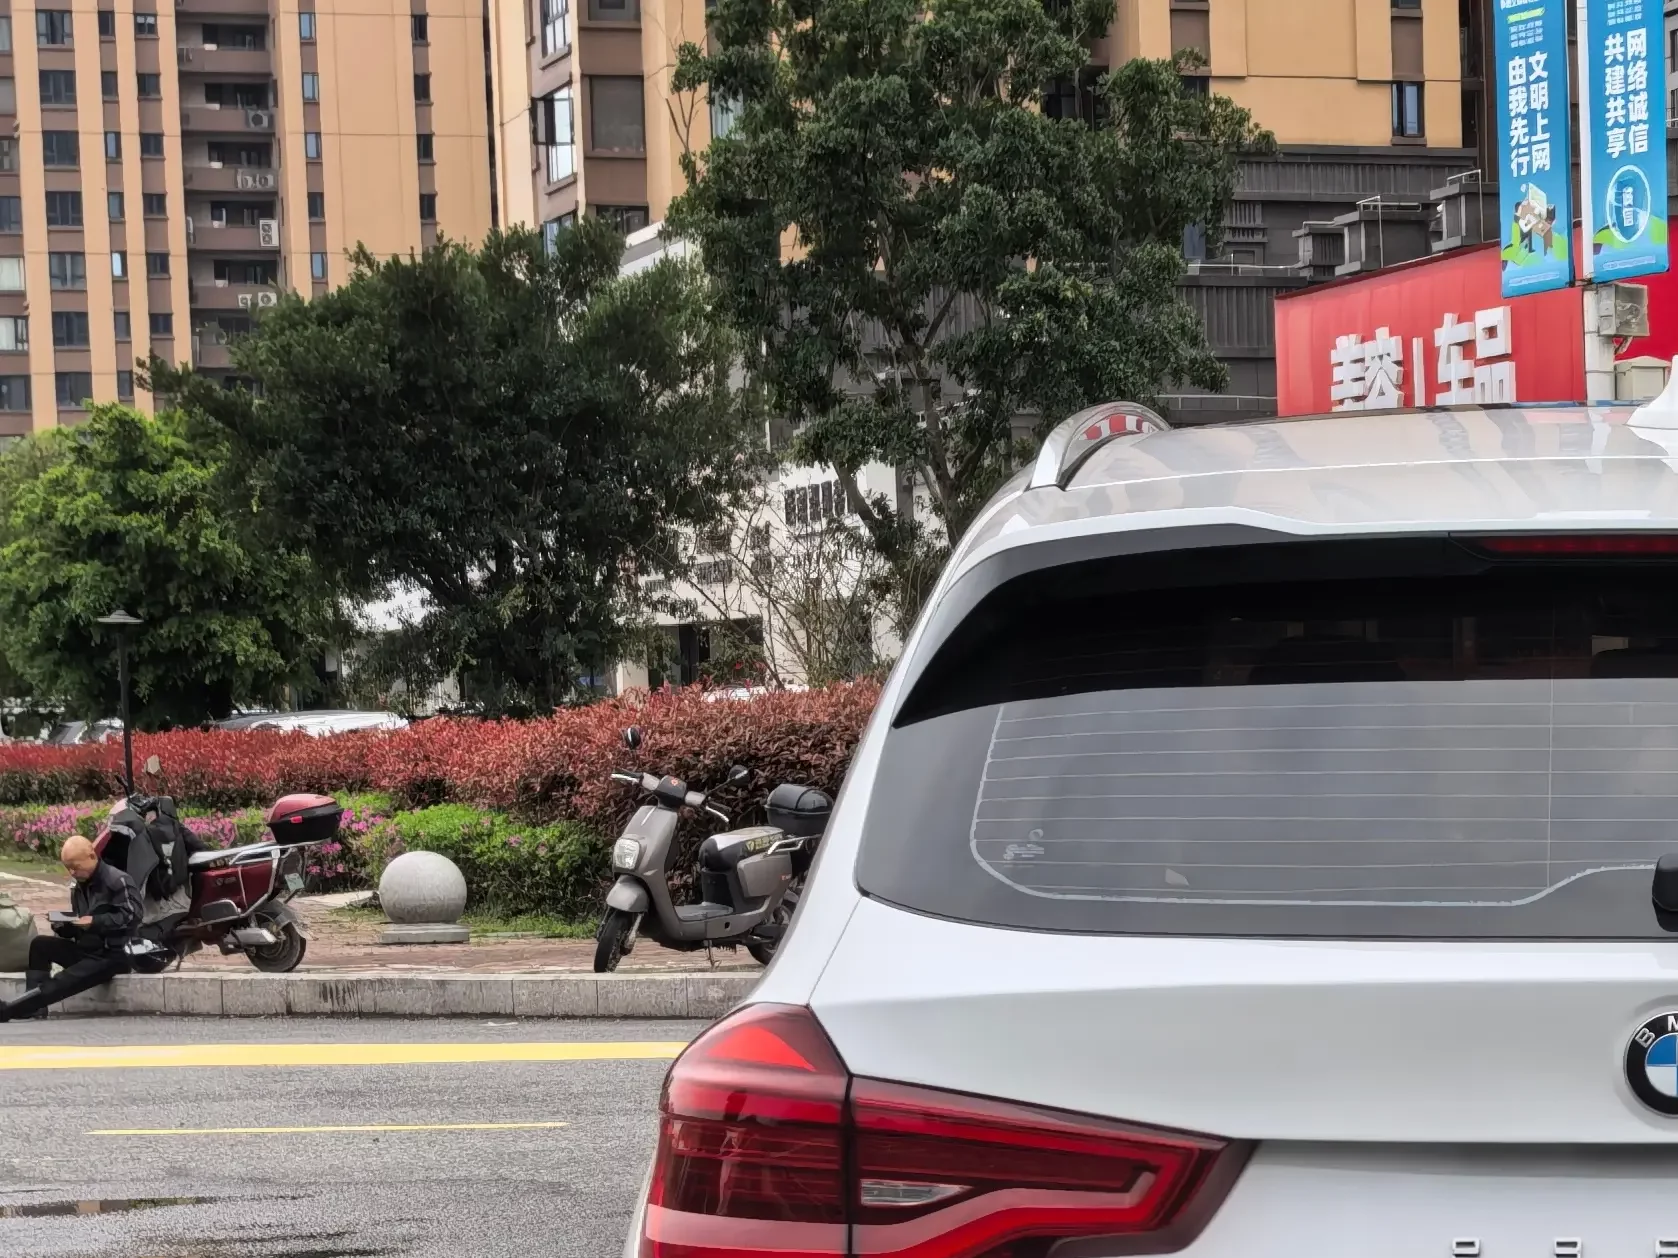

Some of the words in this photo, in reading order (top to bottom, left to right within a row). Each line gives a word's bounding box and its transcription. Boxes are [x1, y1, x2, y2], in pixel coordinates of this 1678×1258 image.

[1508, 56, 1530, 177] 由我先行
[1528, 51, 1551, 174] 文明上网
[1604, 33, 1627, 158] 共建共享
[1626, 28, 1649, 154] 网络诚信
